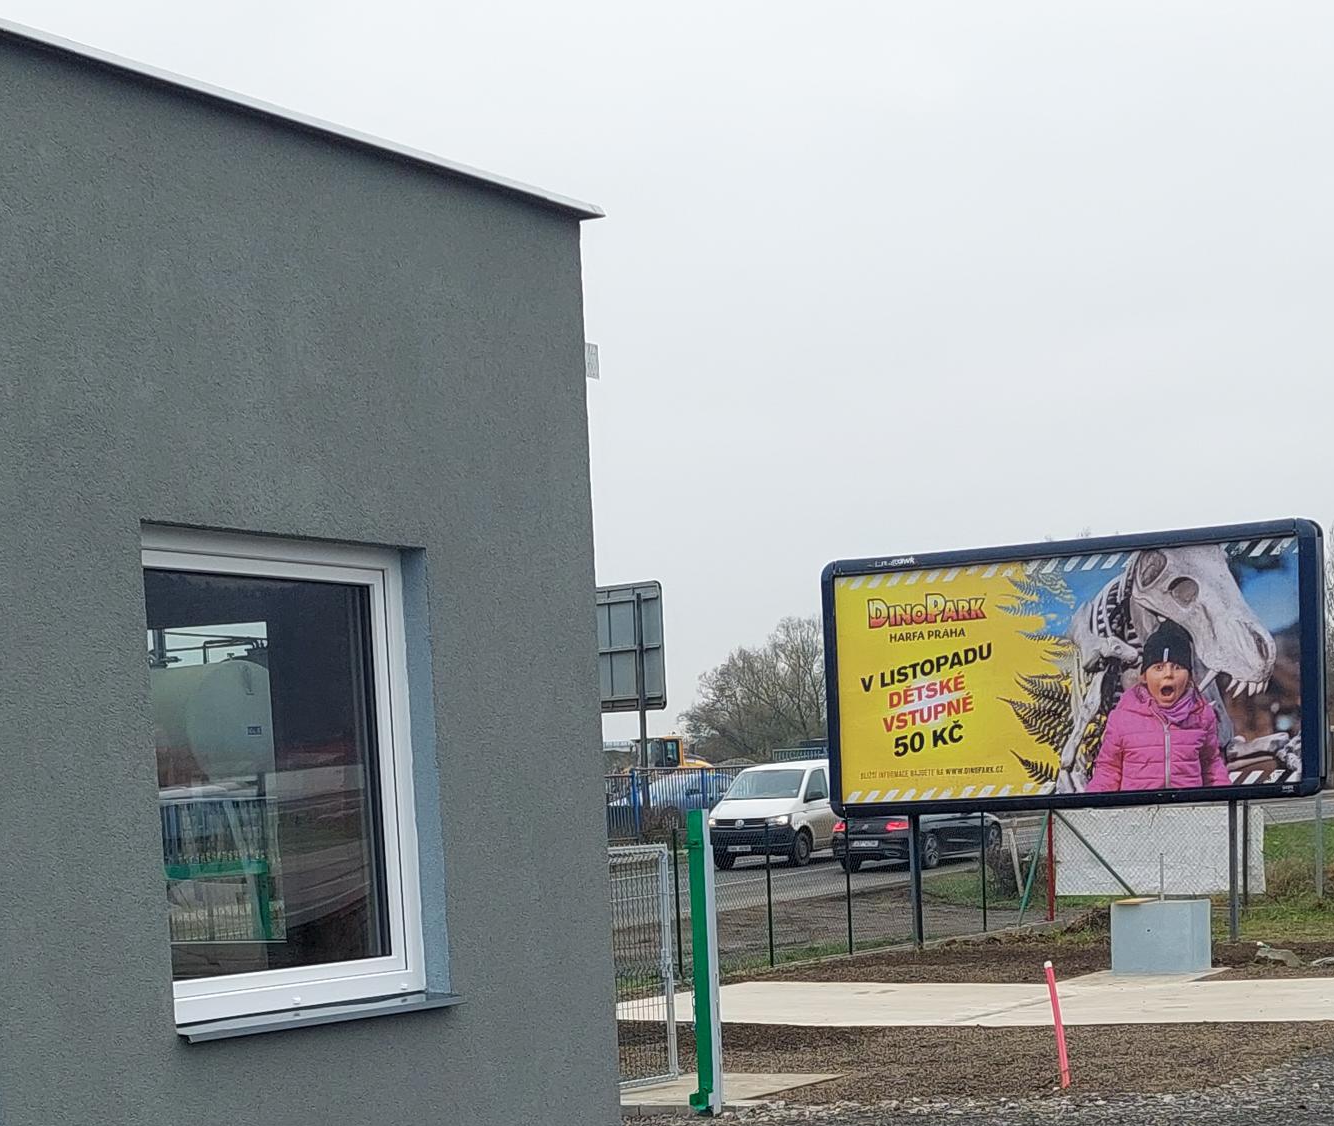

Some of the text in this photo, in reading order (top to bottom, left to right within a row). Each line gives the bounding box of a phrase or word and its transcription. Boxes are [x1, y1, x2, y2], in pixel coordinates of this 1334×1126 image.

[889, 628, 966, 643] HARFA PRAHA
[860, 642, 992, 692] V LISTOPADU
[889, 671, 966, 709] DĚTSKÉ
[883, 692, 974, 733] VSTUPNÉ
[894, 720, 963, 757] 50 KČ
